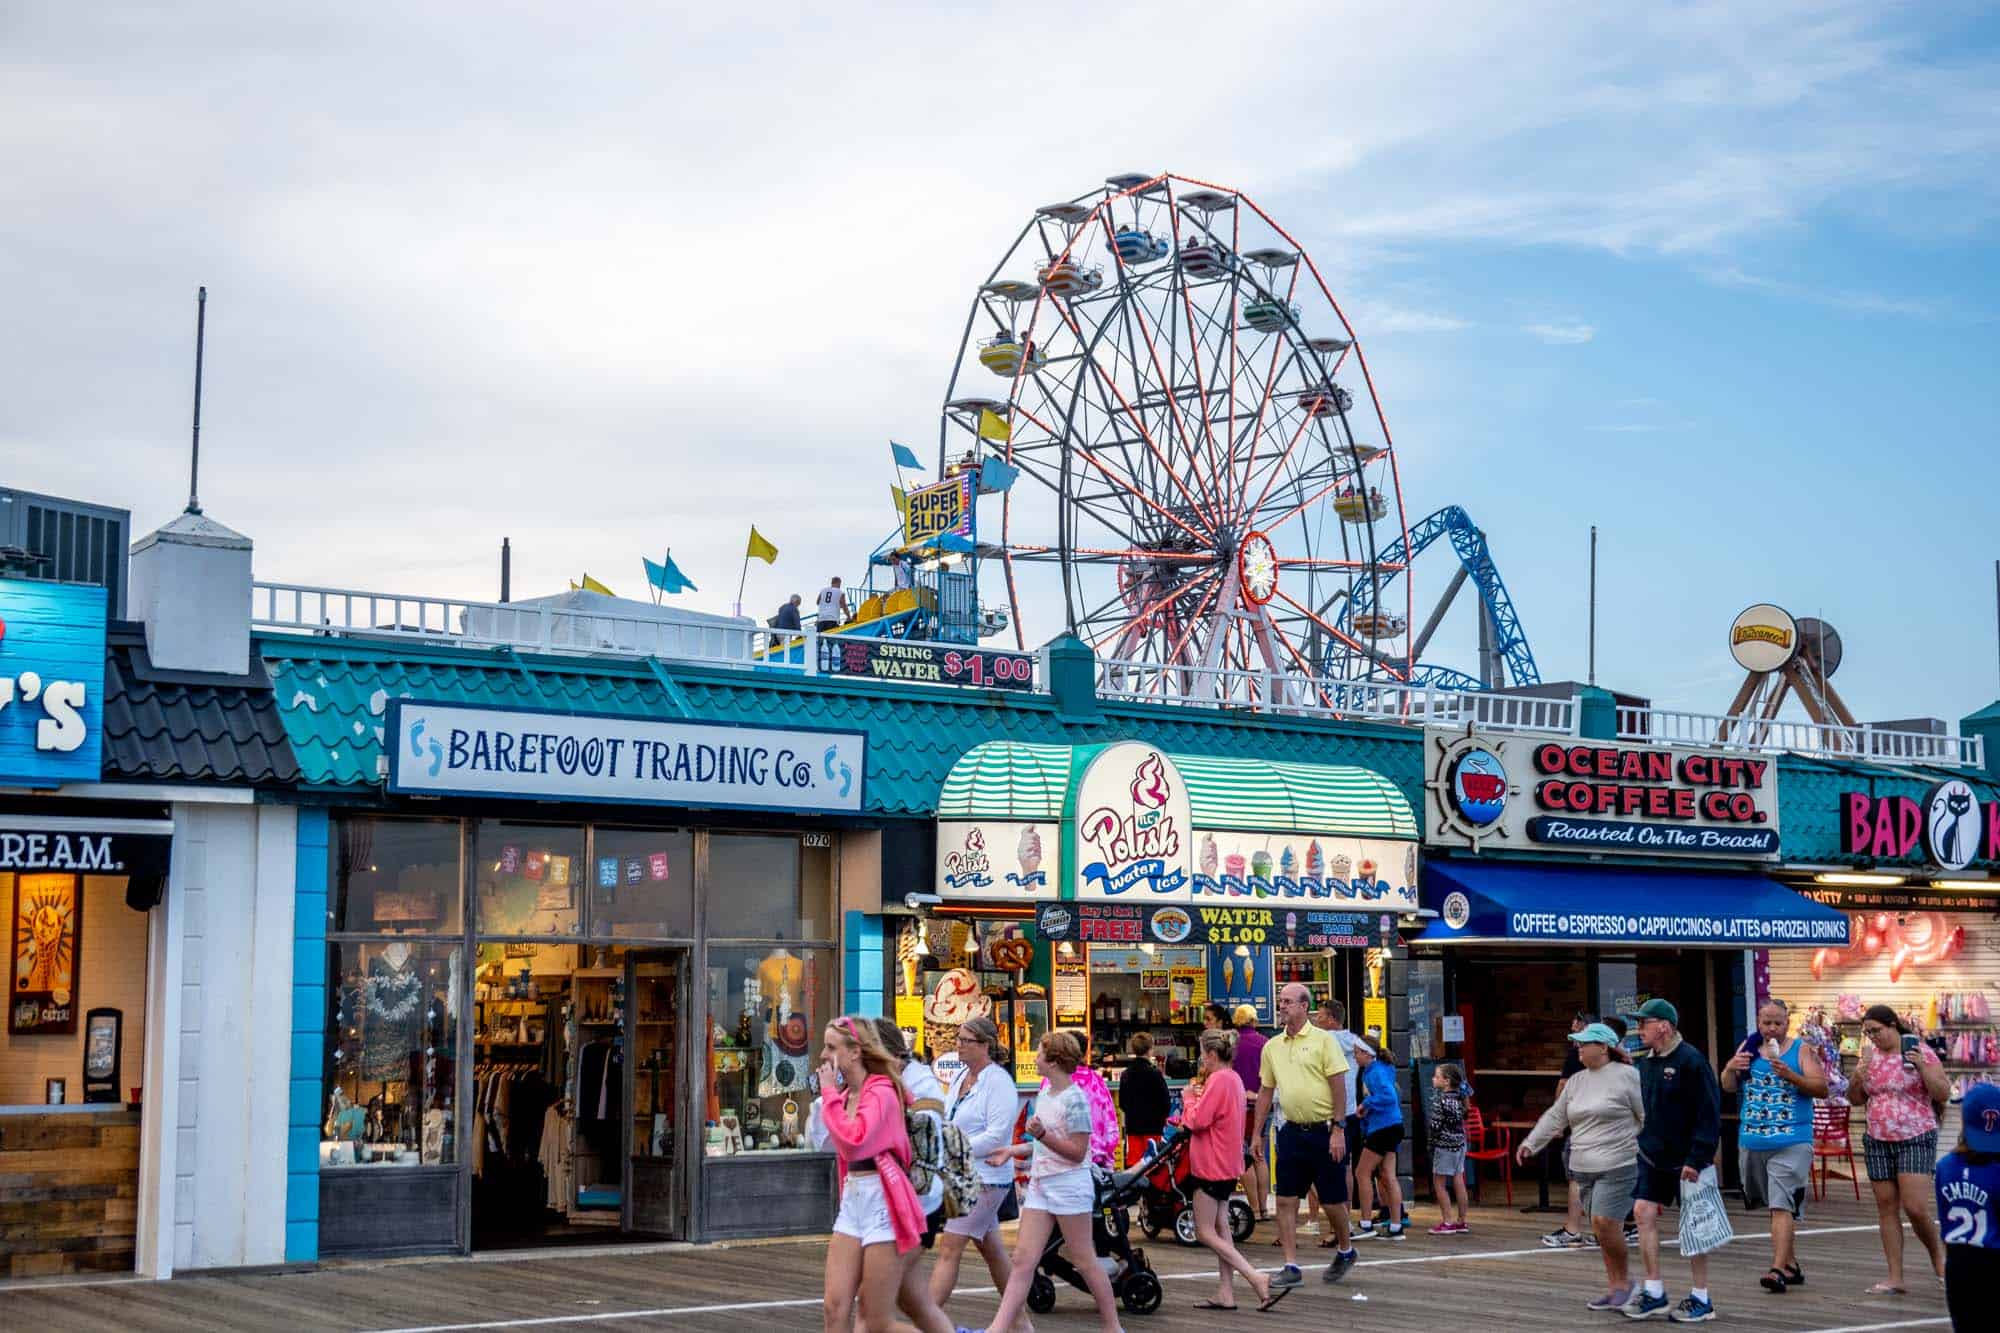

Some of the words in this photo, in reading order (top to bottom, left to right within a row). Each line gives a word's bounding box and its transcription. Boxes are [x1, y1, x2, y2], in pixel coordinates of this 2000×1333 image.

[910, 490, 958, 514] SUPER
[911, 510, 959, 534] SLIDE
[825, 592, 833, 603] 8
[880, 645, 933, 660] SPRING
[872, 659, 940, 680] WATER
[944, 652, 1030, 685] $1.00
[448, 729, 624, 778] BAREFOOT
[633, 740, 768, 786] TRADING
[775, 750, 816, 789] Co.
[1536, 743, 1672, 782] OCEAN
[1682, 755, 1768, 788] CITY
[1539, 780, 1697, 819] COFFEE
[1703, 791, 1767, 823] CO.
[1081, 807, 1179, 867] Polish
[1547, 821, 1635, 843] Roasted
[1638, 828, 1664, 845] On
[1665, 829, 1697, 846] The
[1700, 830, 1770, 849] Beach!
[1851, 792, 1923, 857] BAD
[803, 833, 830, 846] 1070
[945, 851, 989, 877] Polish
[1110, 863, 1158, 890] Water
[1157, 874, 1179, 890] Ice
[1080, 919, 1143, 941] FREE!
[1200, 908, 1274, 926] WATER
[1513, 913, 1556, 933] COFFEE
[1569, 915, 1626, 935] ESPRESSO
[1639, 917, 1712, 937] CAPPUCCINOS
[1723, 918, 1760, 937] LATTES
[1771, 919, 1810, 938] FROZEN
[1811, 921, 1846, 939] DRINKS
[1208, 927, 1266, 943] $1.00
[1308, 935, 1328, 945] ICE
[1329, 935, 1369, 946] CREAM
[1944, 1206, 1988, 1249] 21
